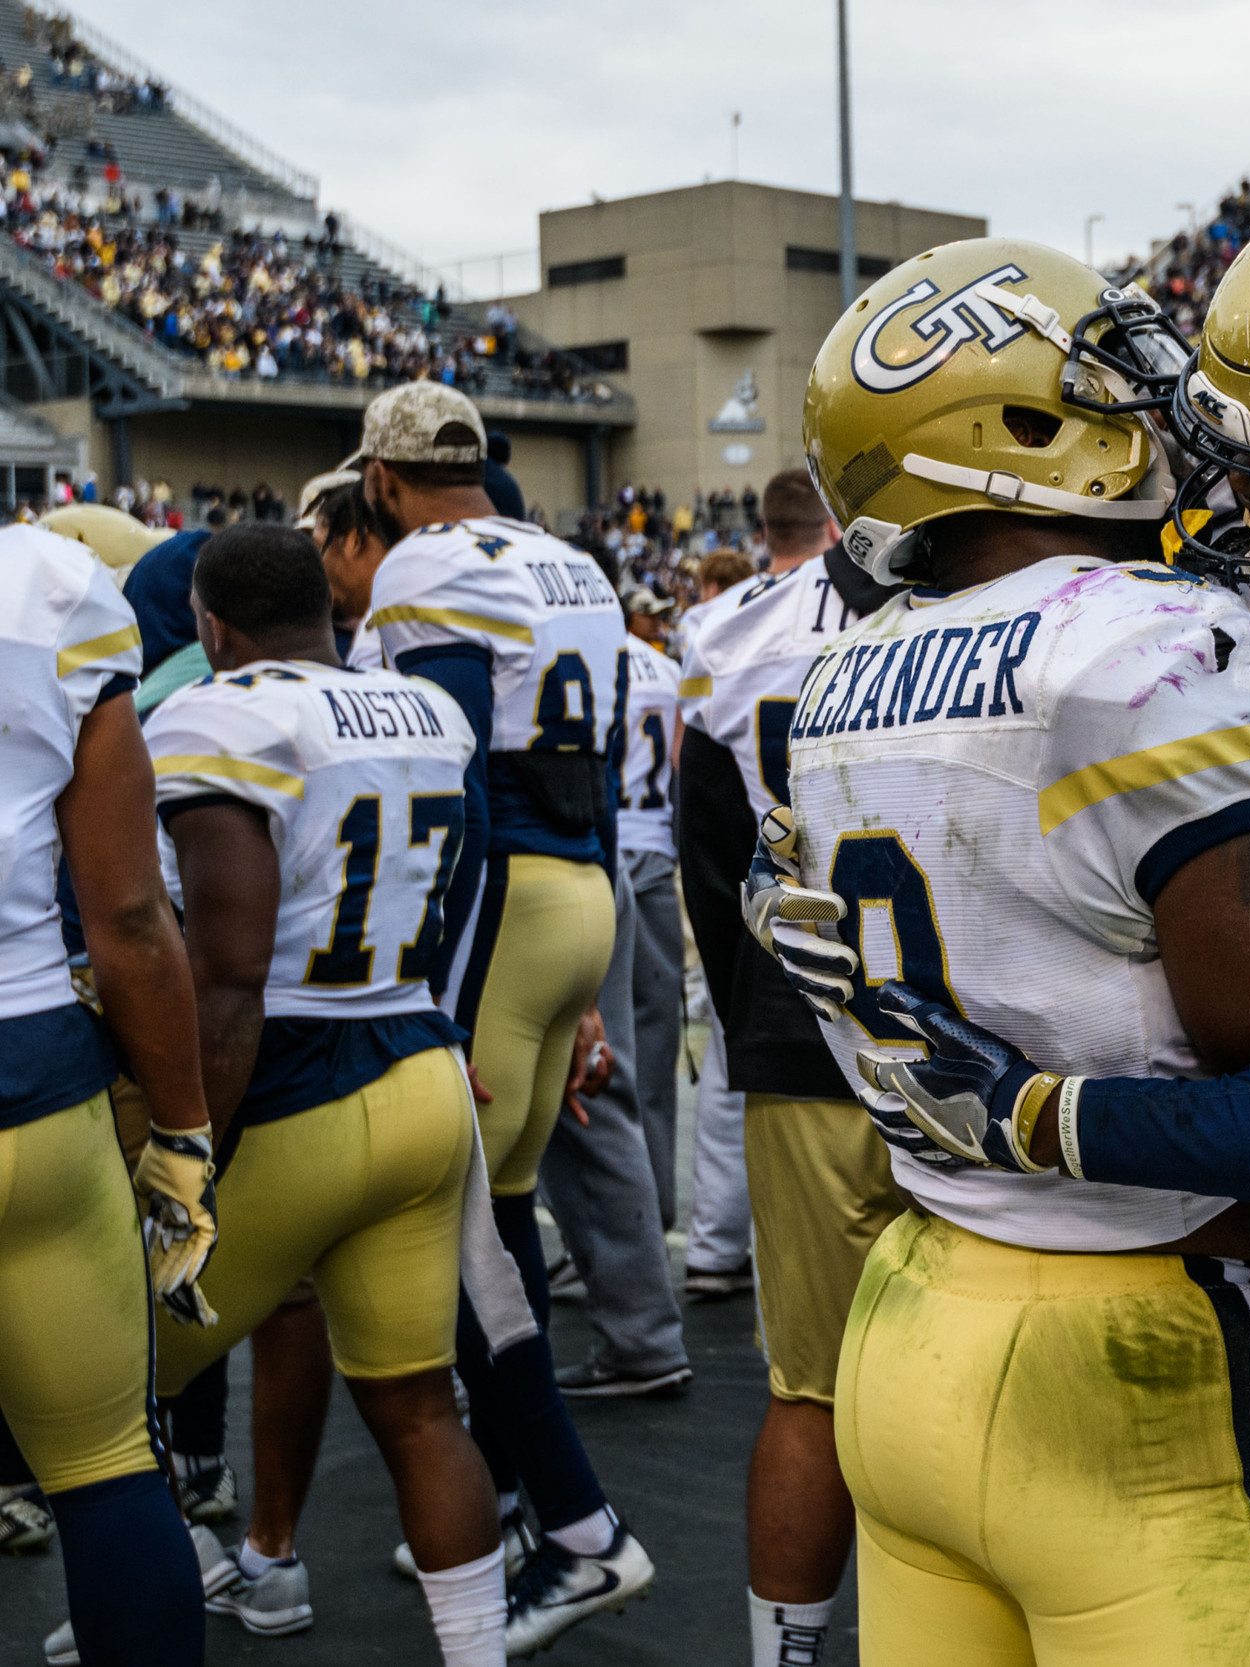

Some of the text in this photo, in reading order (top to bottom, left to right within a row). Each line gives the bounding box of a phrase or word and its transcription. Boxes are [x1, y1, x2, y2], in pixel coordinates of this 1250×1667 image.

[851, 262, 1030, 395] GT
[1192, 390, 1228, 420] ACC
[321, 688, 446, 739] AUSTIN
[302, 789, 468, 986] 17
